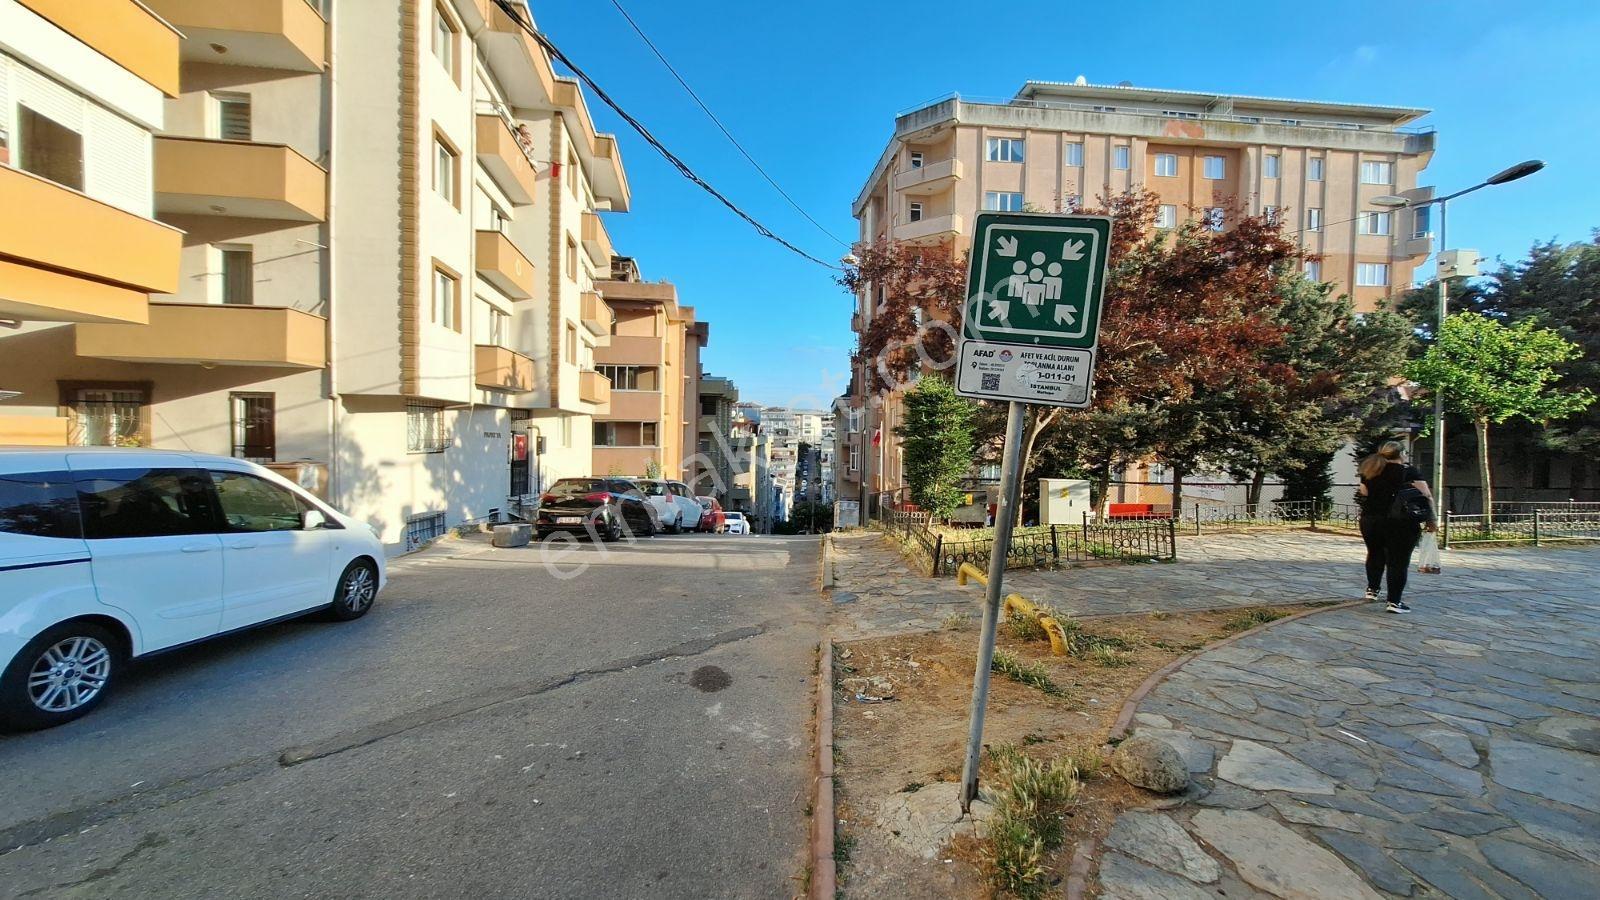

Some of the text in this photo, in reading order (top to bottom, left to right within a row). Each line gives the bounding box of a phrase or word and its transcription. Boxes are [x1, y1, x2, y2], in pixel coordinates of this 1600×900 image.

[973, 349, 994, 358] AFAD
[1020, 352, 1035, 360] AFET
[1043, 353, 1057, 362] ACİL
[1057, 355, 1080, 363] DURUM
[1024, 361, 1056, 370] LANMA
